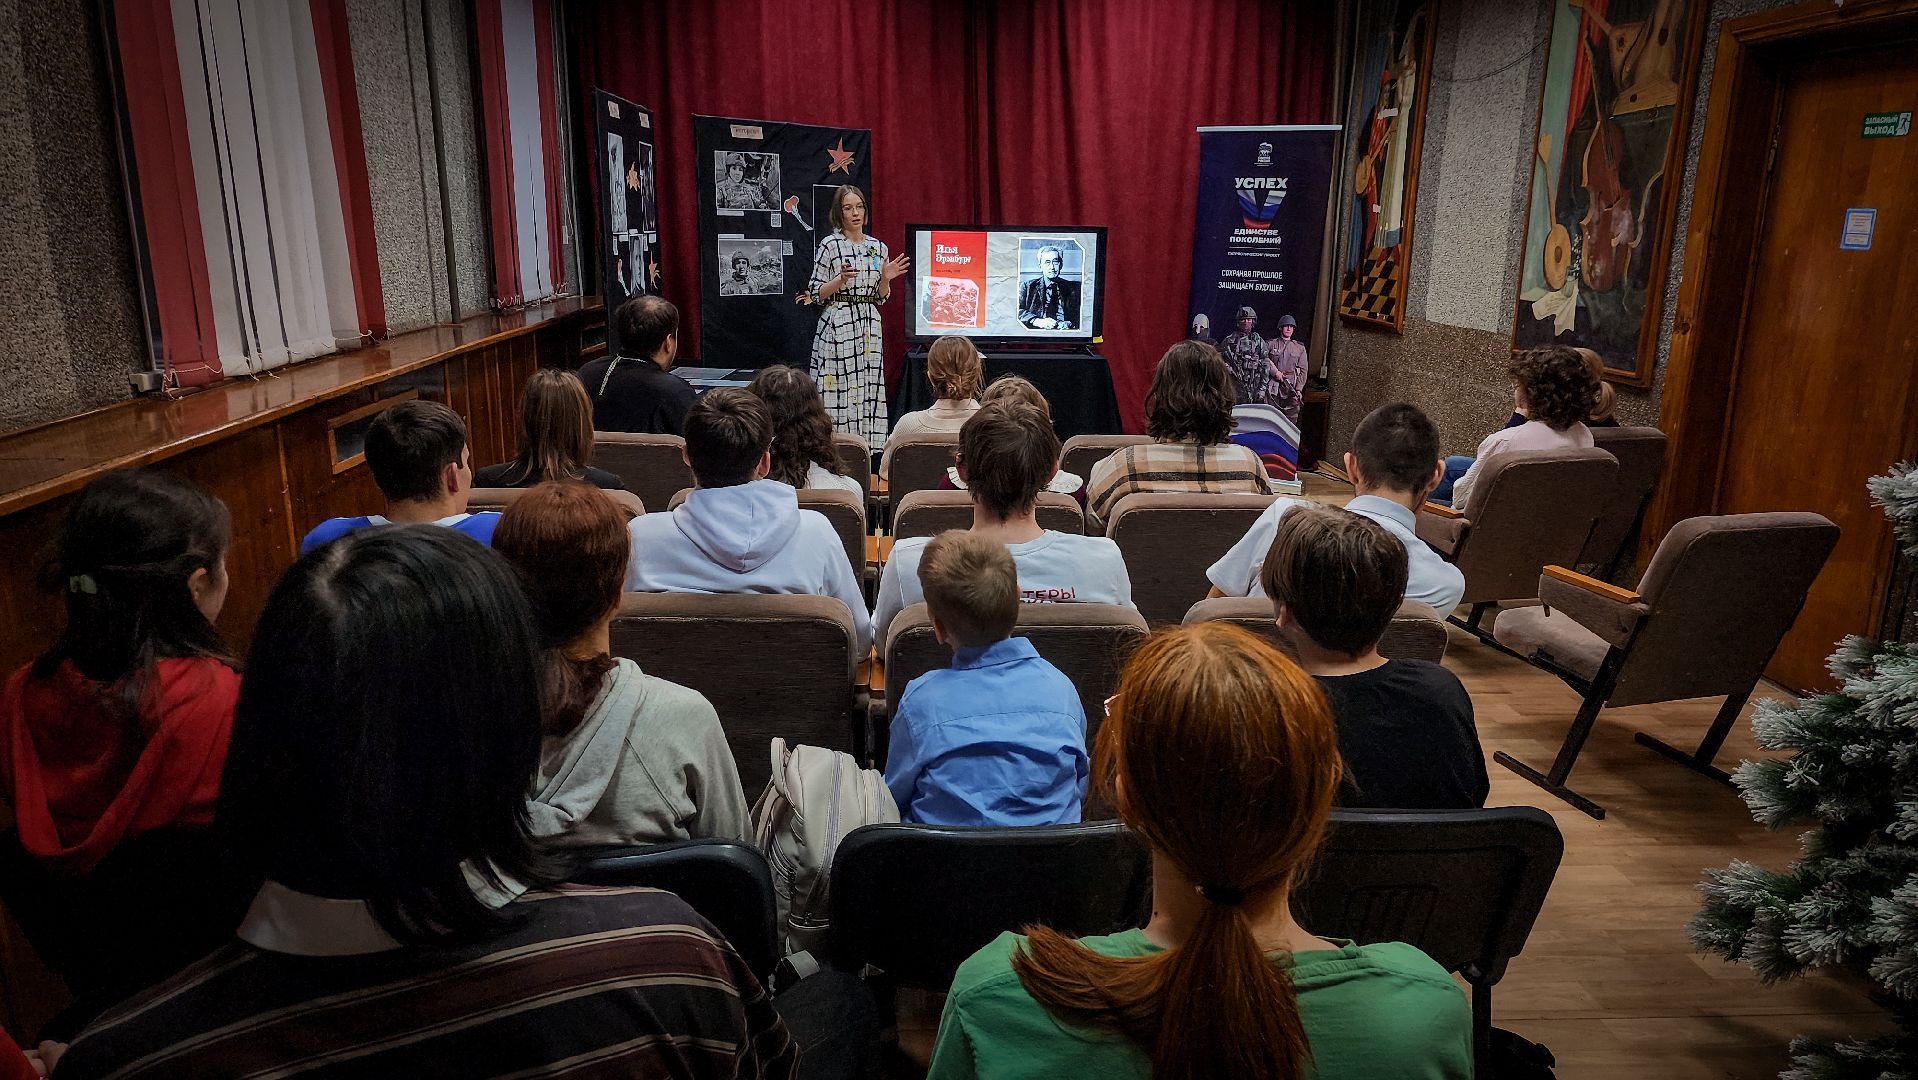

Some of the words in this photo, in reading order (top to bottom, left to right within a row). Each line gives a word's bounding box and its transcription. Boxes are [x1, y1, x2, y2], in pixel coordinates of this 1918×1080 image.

[1865, 115, 1899, 124] ЗАПАСНЫЙ
[1864, 126, 1895, 135] ВЫХОД
[1234, 177, 1289, 189] УСПЕХ
[1234, 228, 1279, 236] ЕДИНСТВЕ
[1229, 236, 1282, 244] ПОКОЛЕНИЙ
[1221, 269, 1252, 278] СОХРАНЯЯ
[1252, 270, 1283, 280] ПРОШЛОЕ
[1217, 281, 1254, 291] ЗАЩИЩАЕМ
[1254, 282, 1284, 292] БУДУЩЕЕ
[1021, 586, 1076, 600] ТЕРЫ
